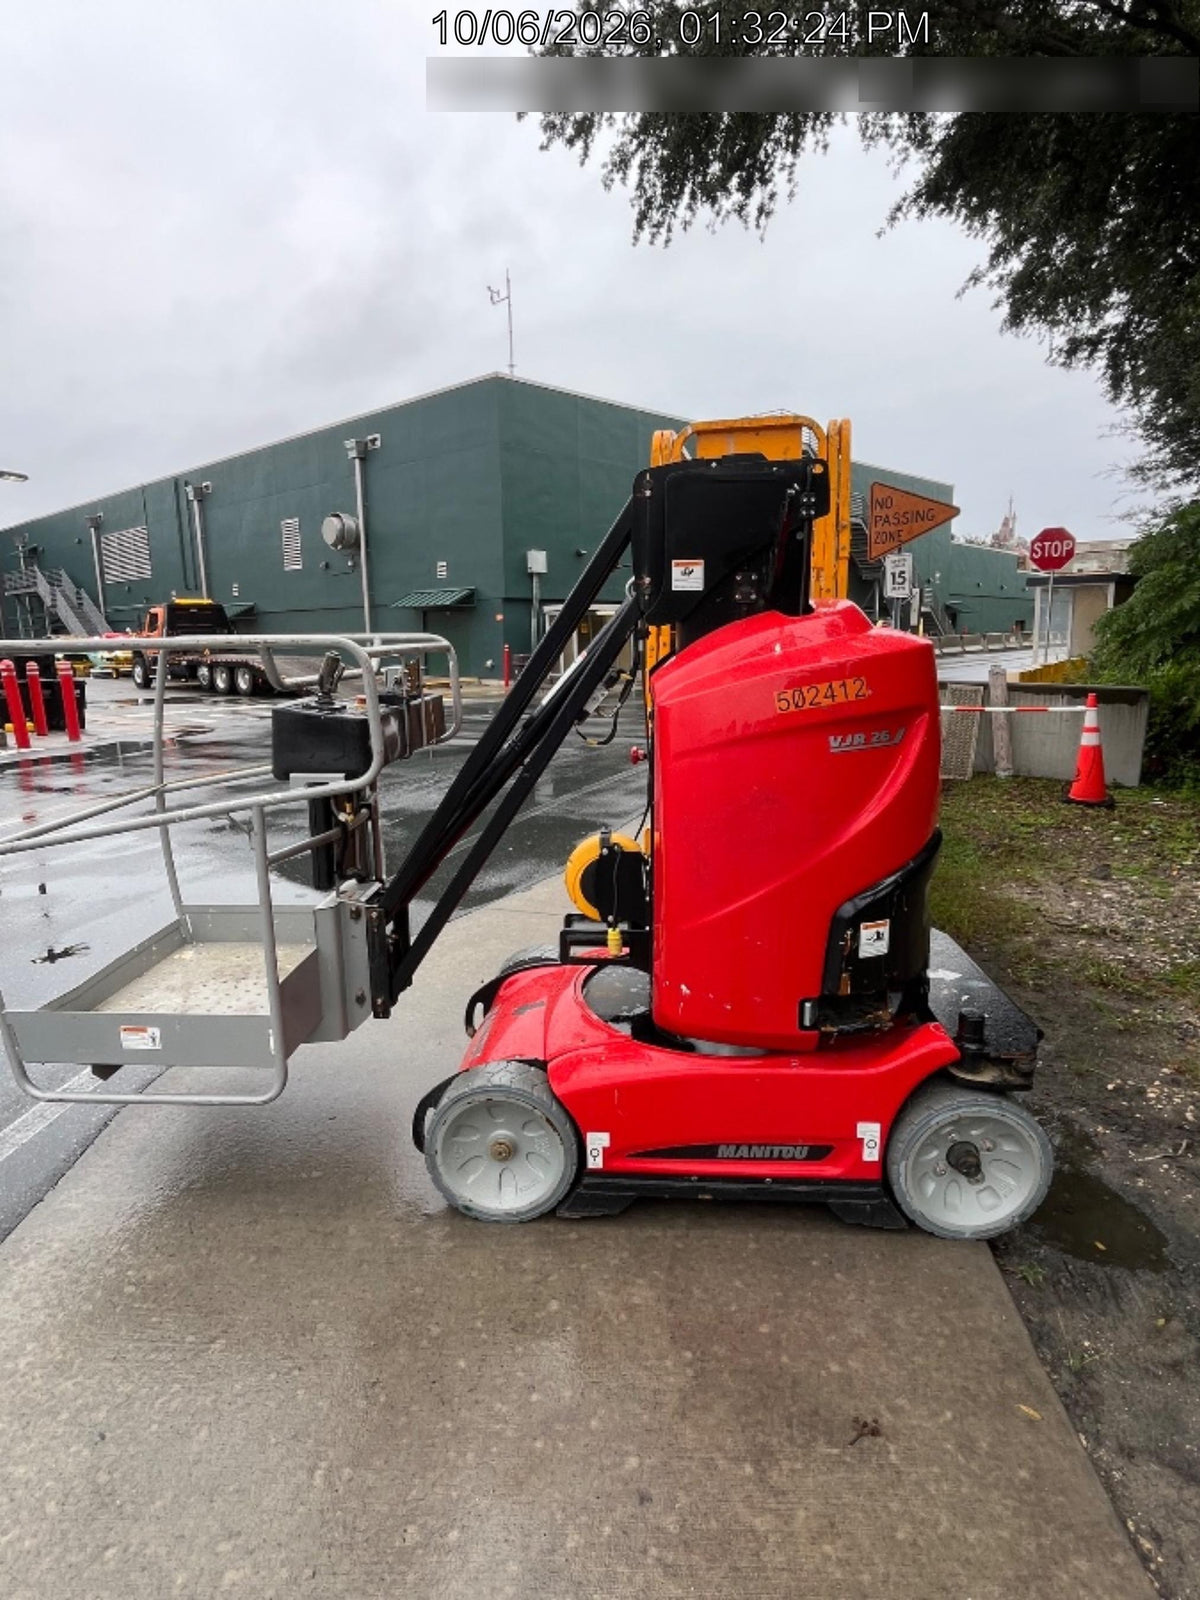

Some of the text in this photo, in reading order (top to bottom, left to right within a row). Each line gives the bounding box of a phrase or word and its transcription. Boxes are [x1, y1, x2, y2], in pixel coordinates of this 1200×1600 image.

[874, 496, 893, 511] NO
[874, 508, 936, 528] PASSING
[873, 529, 904, 545] ZONE
[1032, 540, 1073, 559] STOP
[890, 570, 907, 586] 15
[776, 677, 867, 712] 502412
[828, 733, 866, 748] VJR
[717, 1144, 809, 1160] MANITOU
